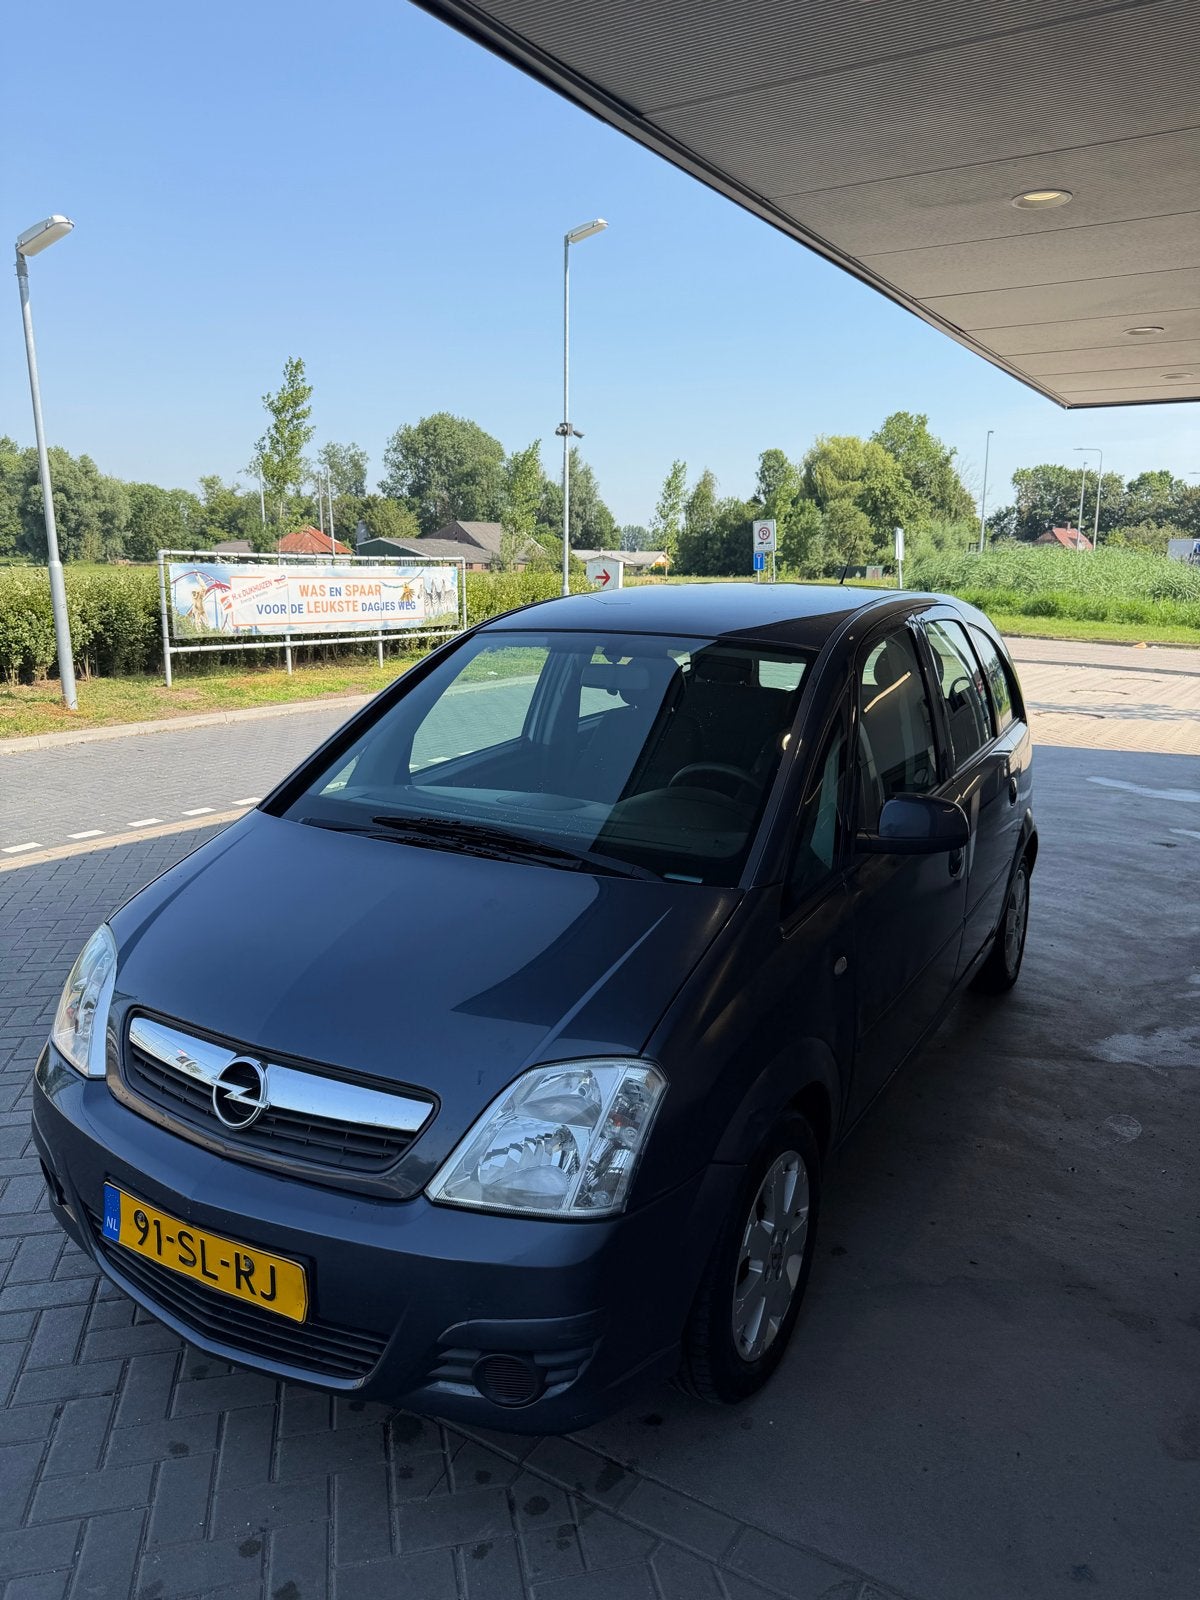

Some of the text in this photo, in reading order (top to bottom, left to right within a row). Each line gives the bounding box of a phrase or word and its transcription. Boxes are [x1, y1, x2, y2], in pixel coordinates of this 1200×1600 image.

[299, 585, 326, 597] WAS
[329, 587, 342, 597] EN
[345, 584, 381, 596] SPAAR
[256, 600, 416, 615] VOOR DE LEUKSTE DAGJES WEG
[106, 1216, 118, 1232] NL
[134, 1209, 276, 1301] 91-SL-RJ
